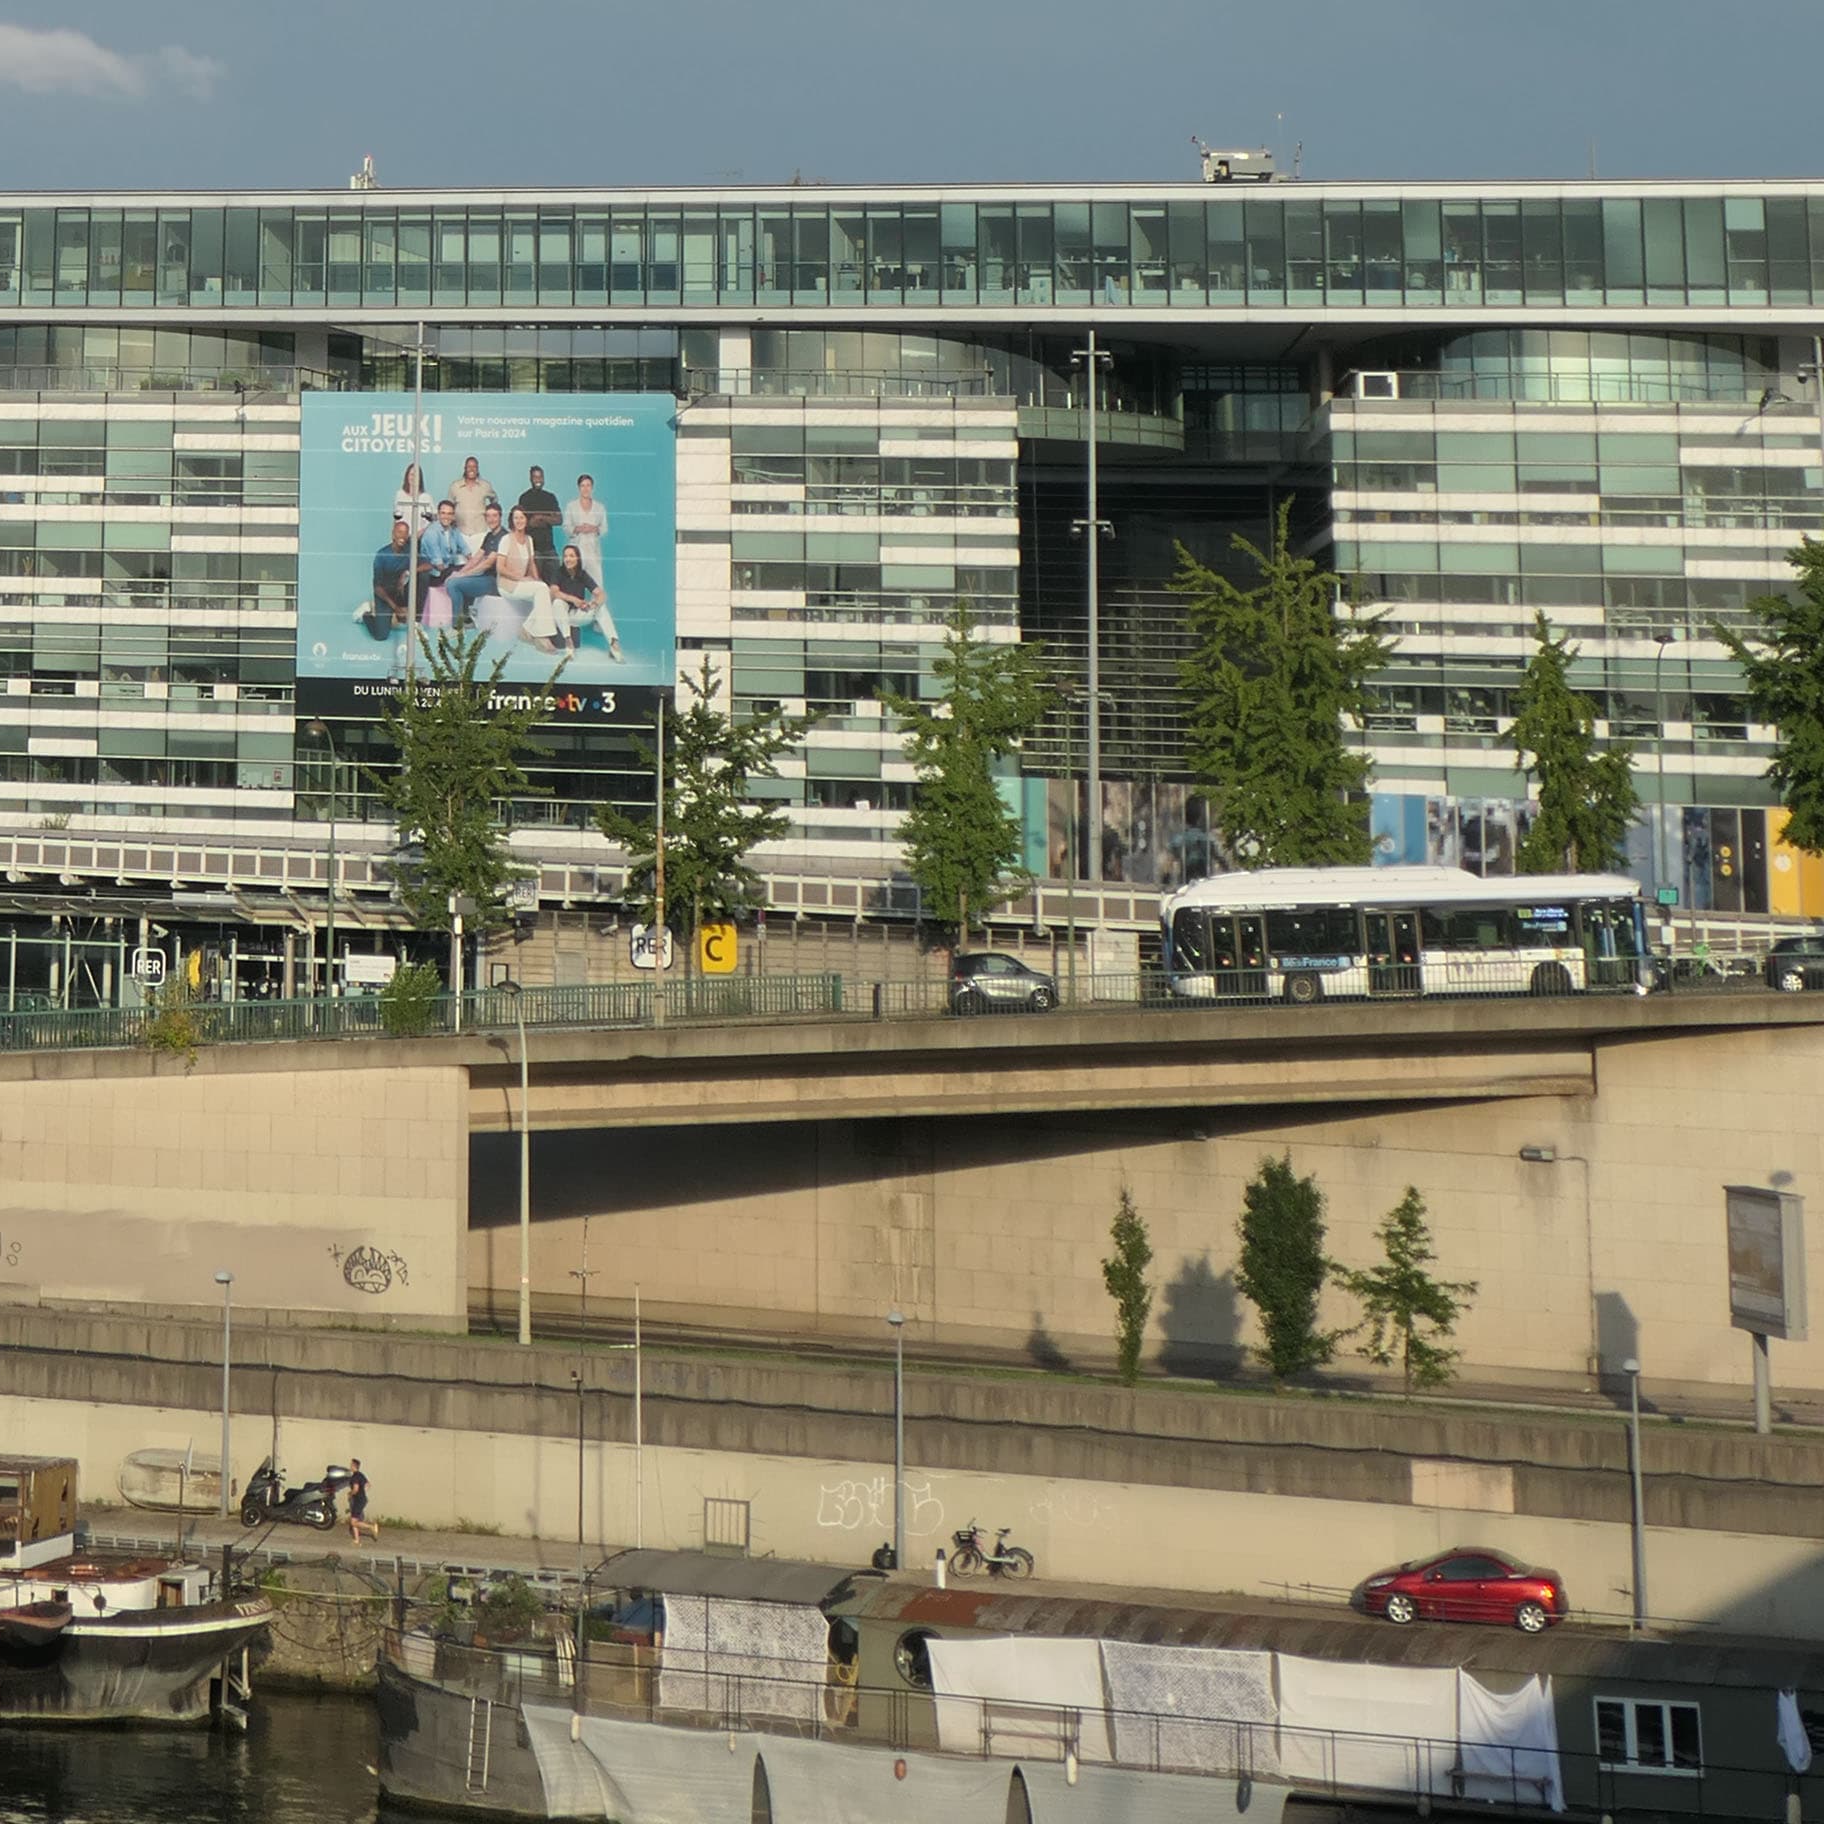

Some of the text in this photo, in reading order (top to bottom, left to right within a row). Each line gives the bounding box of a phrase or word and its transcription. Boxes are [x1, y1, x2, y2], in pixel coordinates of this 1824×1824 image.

[457, 415, 634, 428] Votre nouveau magazine quotidien
[342, 426, 368, 436] AUX
[457, 428, 526, 439] sur Paris 2024
[354, 686, 369, 695] DU
[705, 935, 723, 962] C
[136, 959, 161, 975] RER
